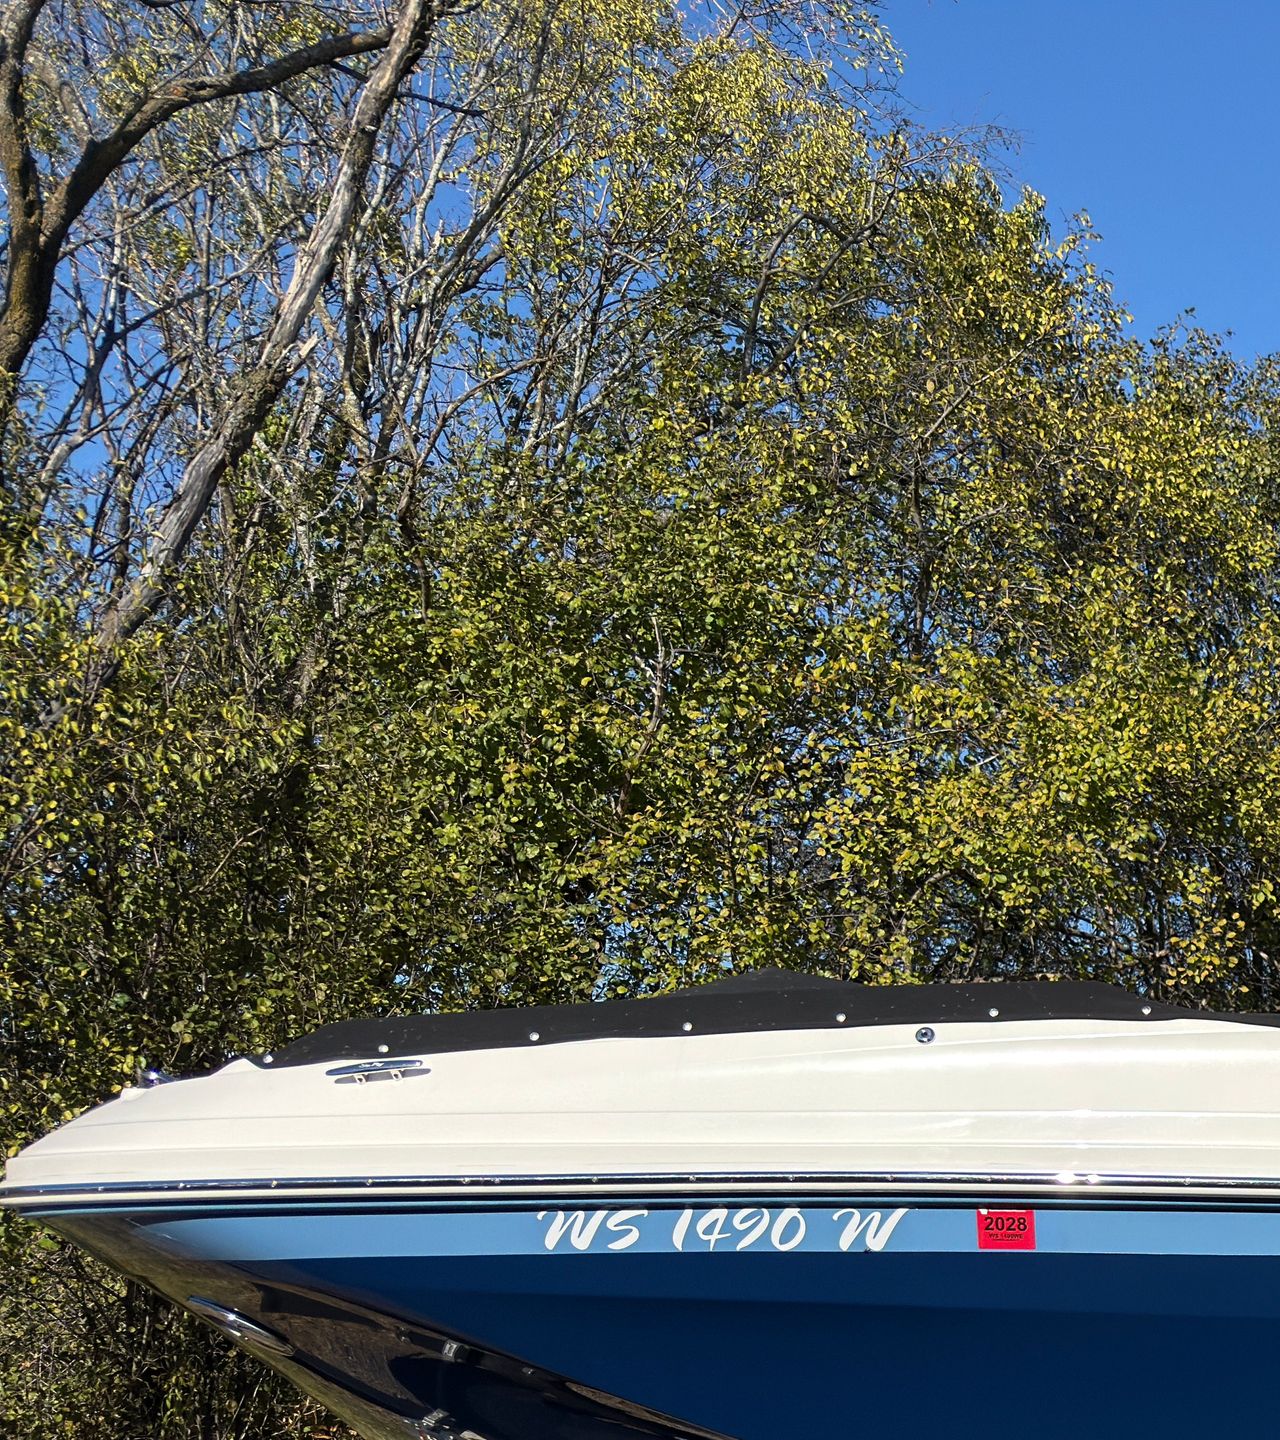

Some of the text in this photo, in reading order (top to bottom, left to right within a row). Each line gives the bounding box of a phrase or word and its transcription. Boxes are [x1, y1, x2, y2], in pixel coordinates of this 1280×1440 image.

[536, 1208, 911, 1251] WS 1490 W
[984, 1216, 1028, 1232] 2028
